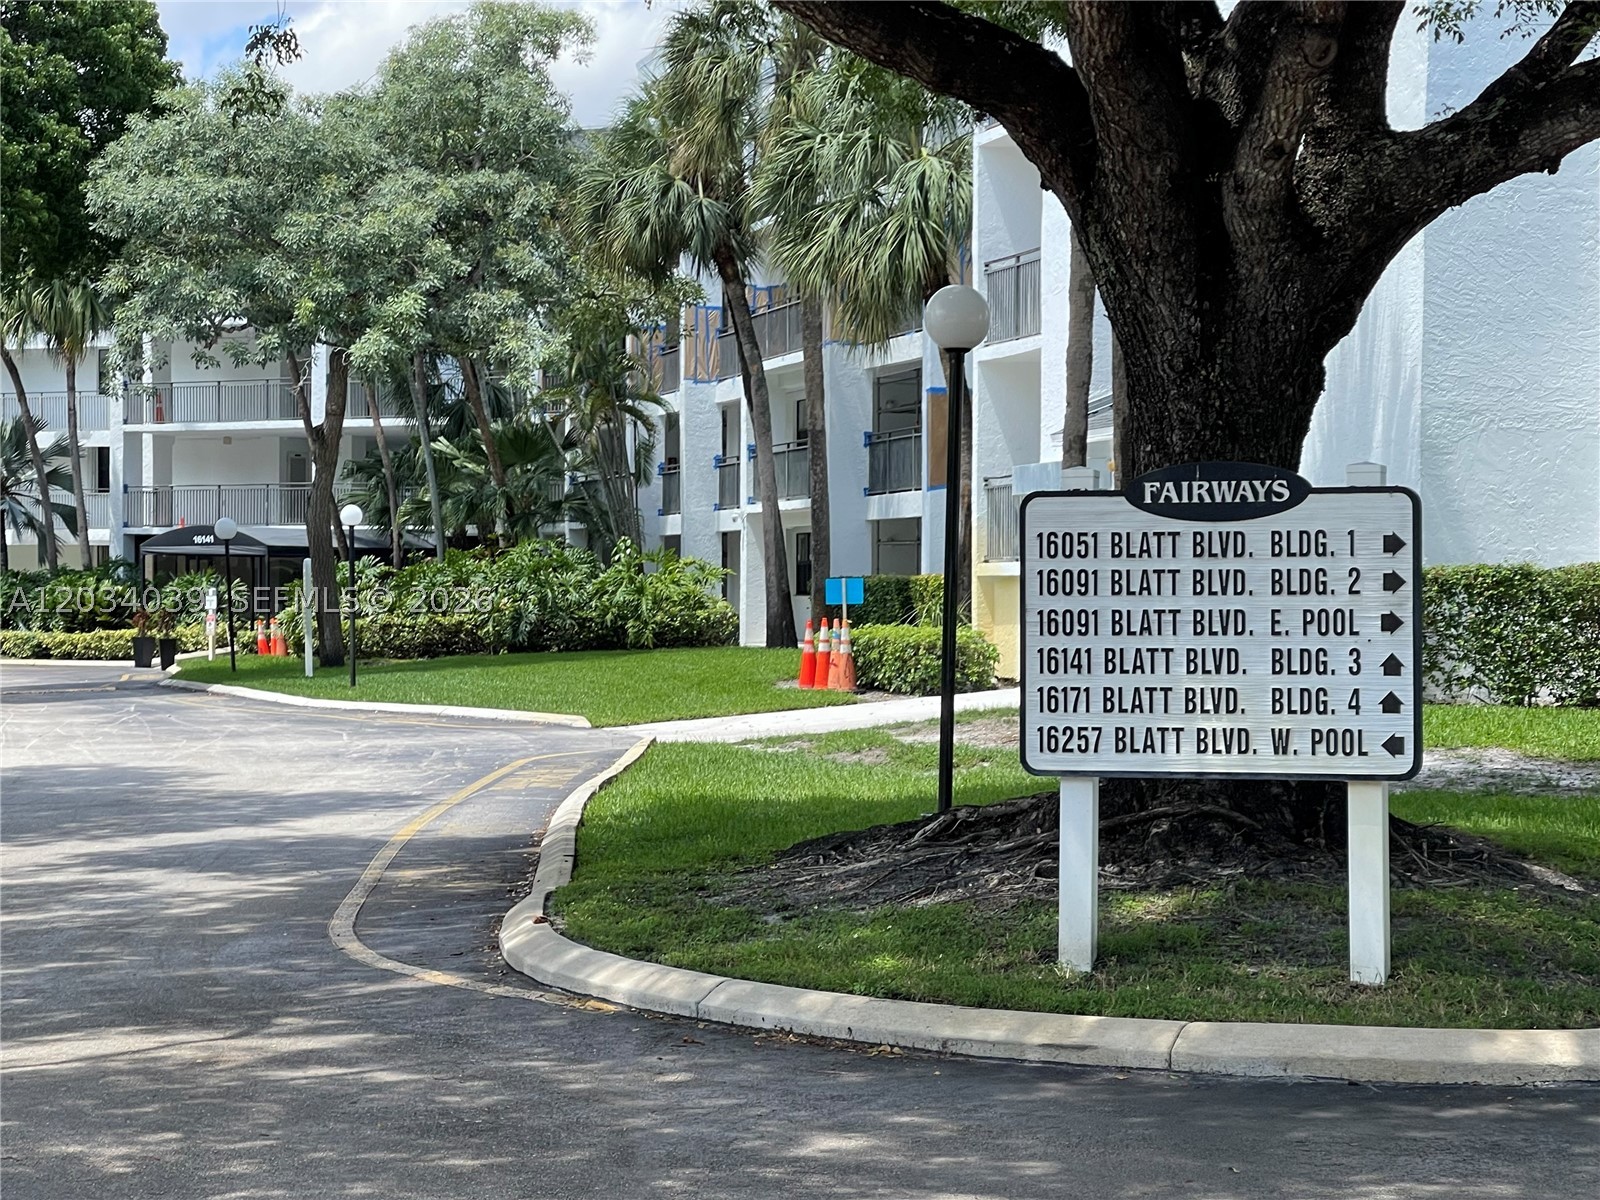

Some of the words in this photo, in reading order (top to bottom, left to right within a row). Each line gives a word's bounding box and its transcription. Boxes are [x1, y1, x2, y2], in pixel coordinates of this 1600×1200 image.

[1143, 480, 1290, 504] FAIRWAYS
[192, 534, 214, 544] 16141
[1036, 531, 1099, 559] 16051
[1110, 531, 1181, 559] BLATT
[1192, 530, 1253, 559] BLVD.
[1270, 530, 1335, 558] BLDG.
[1347, 529, 1355, 557] 1
[1036, 568, 1099, 597] 16091
[1110, 568, 1181, 596] BLATT
[1192, 568, 1253, 597] BLVD.
[1271, 568, 1335, 596] BLDG.
[1348, 567, 1361, 595] 2
[1036, 608, 1099, 637] 16091
[1111, 608, 1182, 637] BLATT
[1192, 608, 1254, 637] BLVD.
[1270, 608, 1290, 637] E.
[1302, 608, 1360, 637] POOL
[1037, 647, 1092, 675] 16141
[1104, 647, 1175, 675] BLATT
[1185, 647, 1247, 675] BLVD.
[1271, 647, 1336, 676] BLDG.
[1348, 647, 1362, 676] 3
[1037, 685, 1091, 714] 16171
[1102, 686, 1173, 714] BLATT
[1184, 687, 1245, 715] BLVD.
[1271, 687, 1336, 716] BLDG.
[1347, 688, 1361, 716] 4
[1036, 725, 1103, 754] 16257
[1114, 726, 1185, 754] BLATT
[1196, 727, 1257, 755] BLVD.
[1270, 728, 1298, 756] W.
[1311, 728, 1369, 757] POOL
